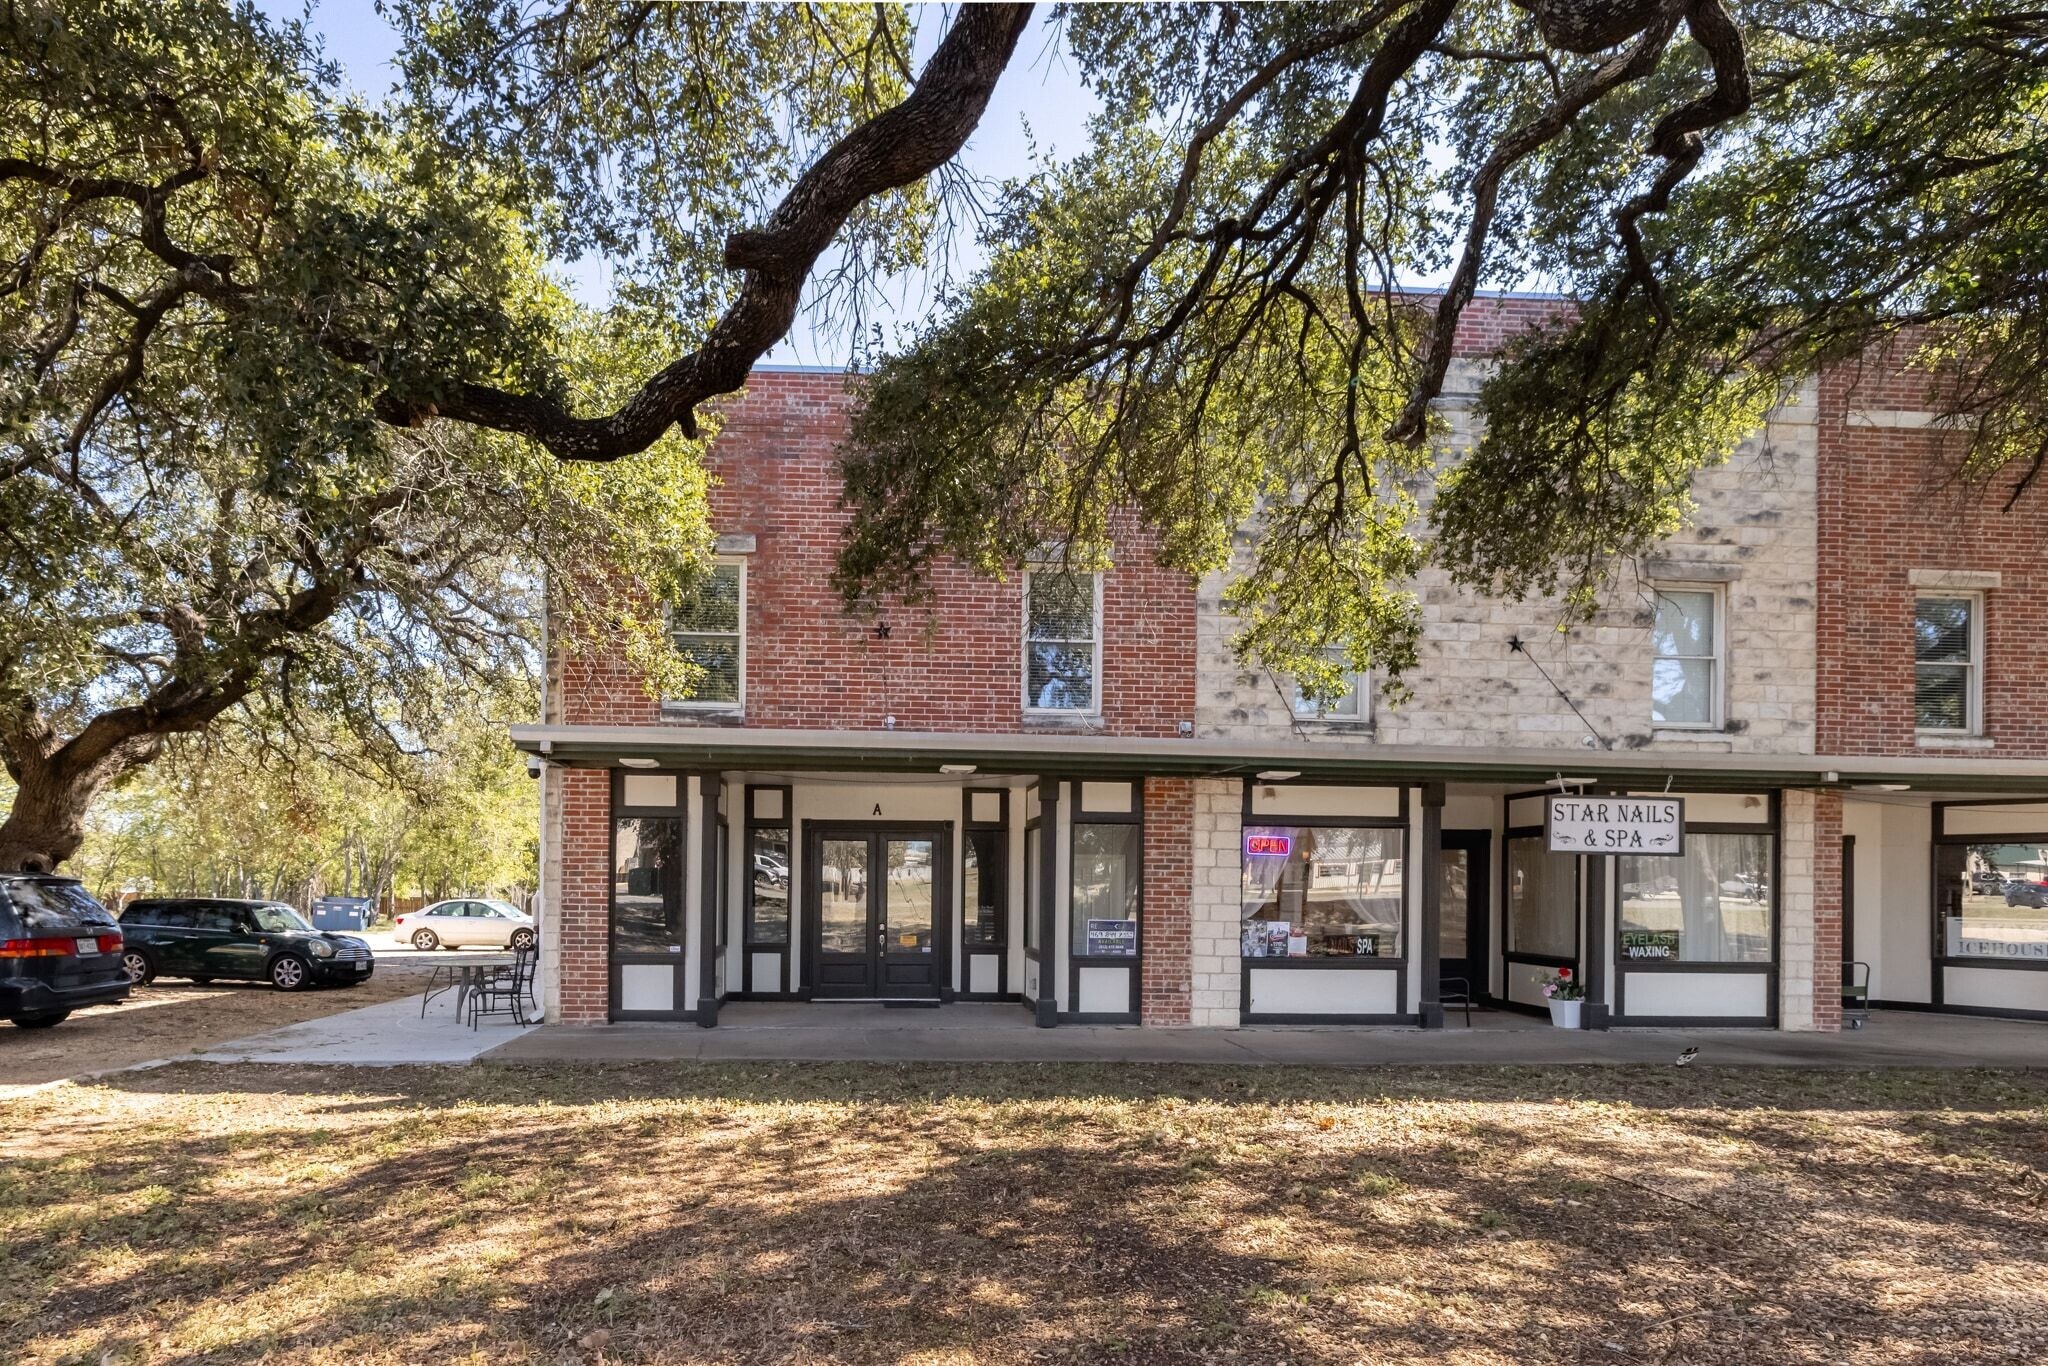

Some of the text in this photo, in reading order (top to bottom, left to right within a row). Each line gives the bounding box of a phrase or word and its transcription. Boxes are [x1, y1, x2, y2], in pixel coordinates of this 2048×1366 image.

[872, 803, 882, 816] A
[1553, 803, 1675, 824] STAR NAILS
[1250, 838, 1288, 853] OPEN
[1584, 829, 1643, 848] & SPA
[1356, 938, 1373, 954] SPA
[1623, 933, 1675, 945] EYELASH
[1629, 946, 1670, 957] WAXING
[1959, 941, 2048, 957] ICEHOUS
